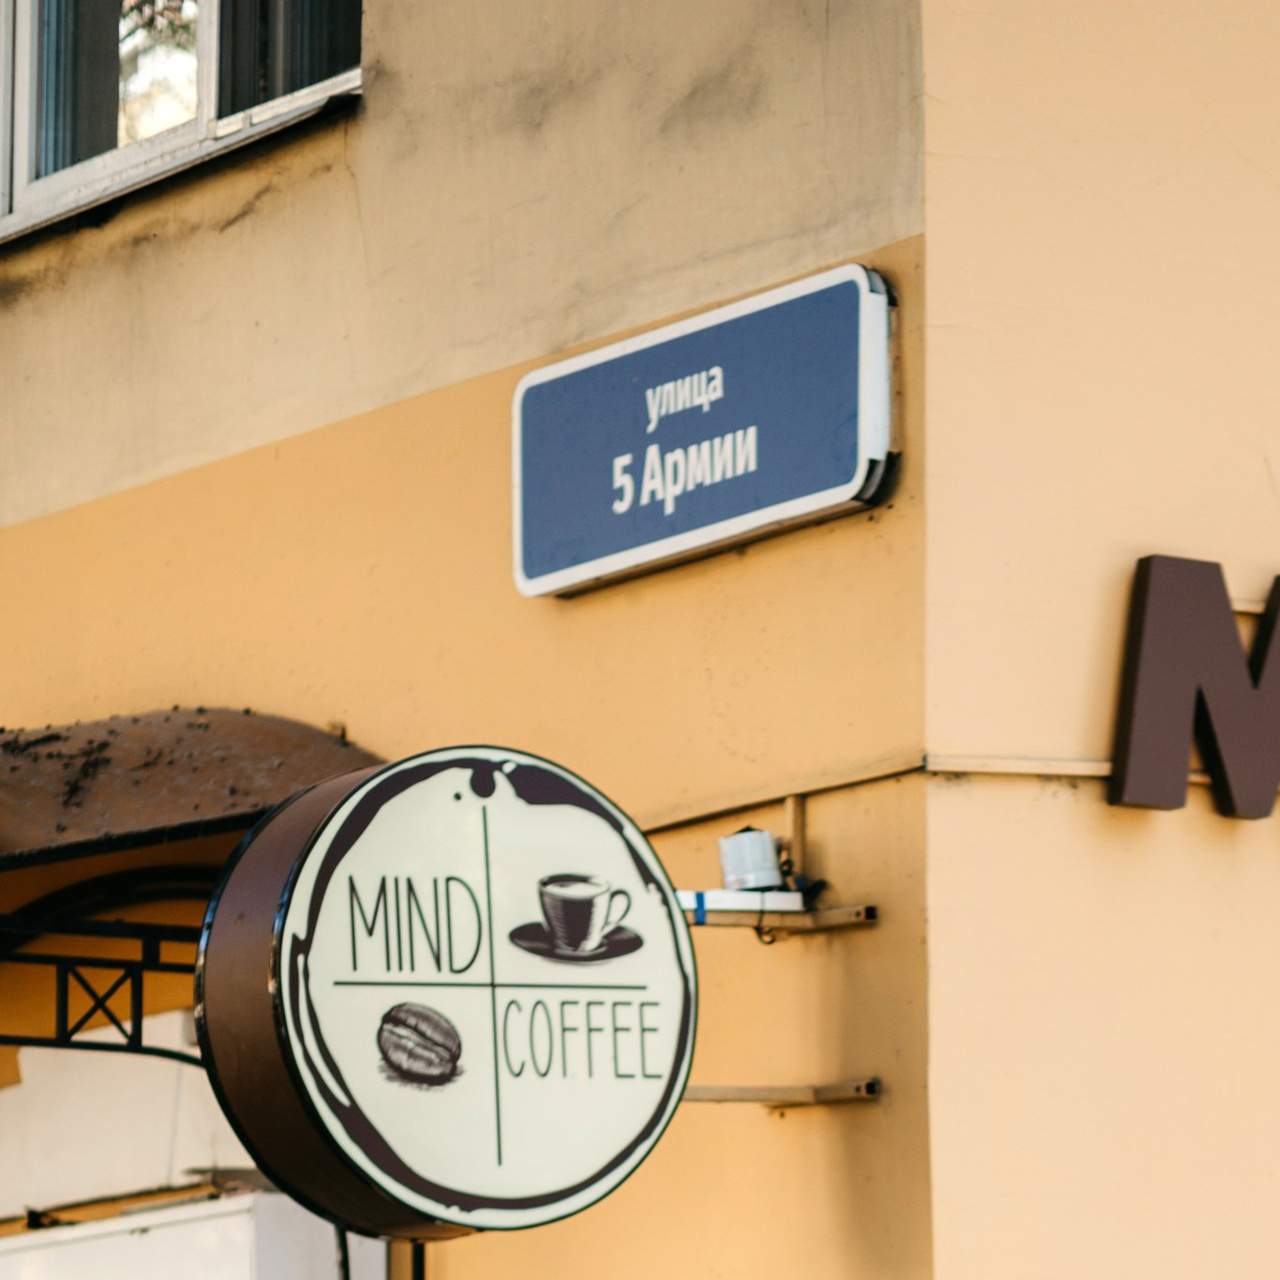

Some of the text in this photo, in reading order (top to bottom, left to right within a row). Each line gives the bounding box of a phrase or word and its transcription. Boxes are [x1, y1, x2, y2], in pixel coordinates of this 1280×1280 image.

[645, 365, 724, 433] улица
[612, 426, 757, 516] 5 Армии
[349, 875, 482, 974] MIND
[503, 1000, 663, 1079] COFFEE
